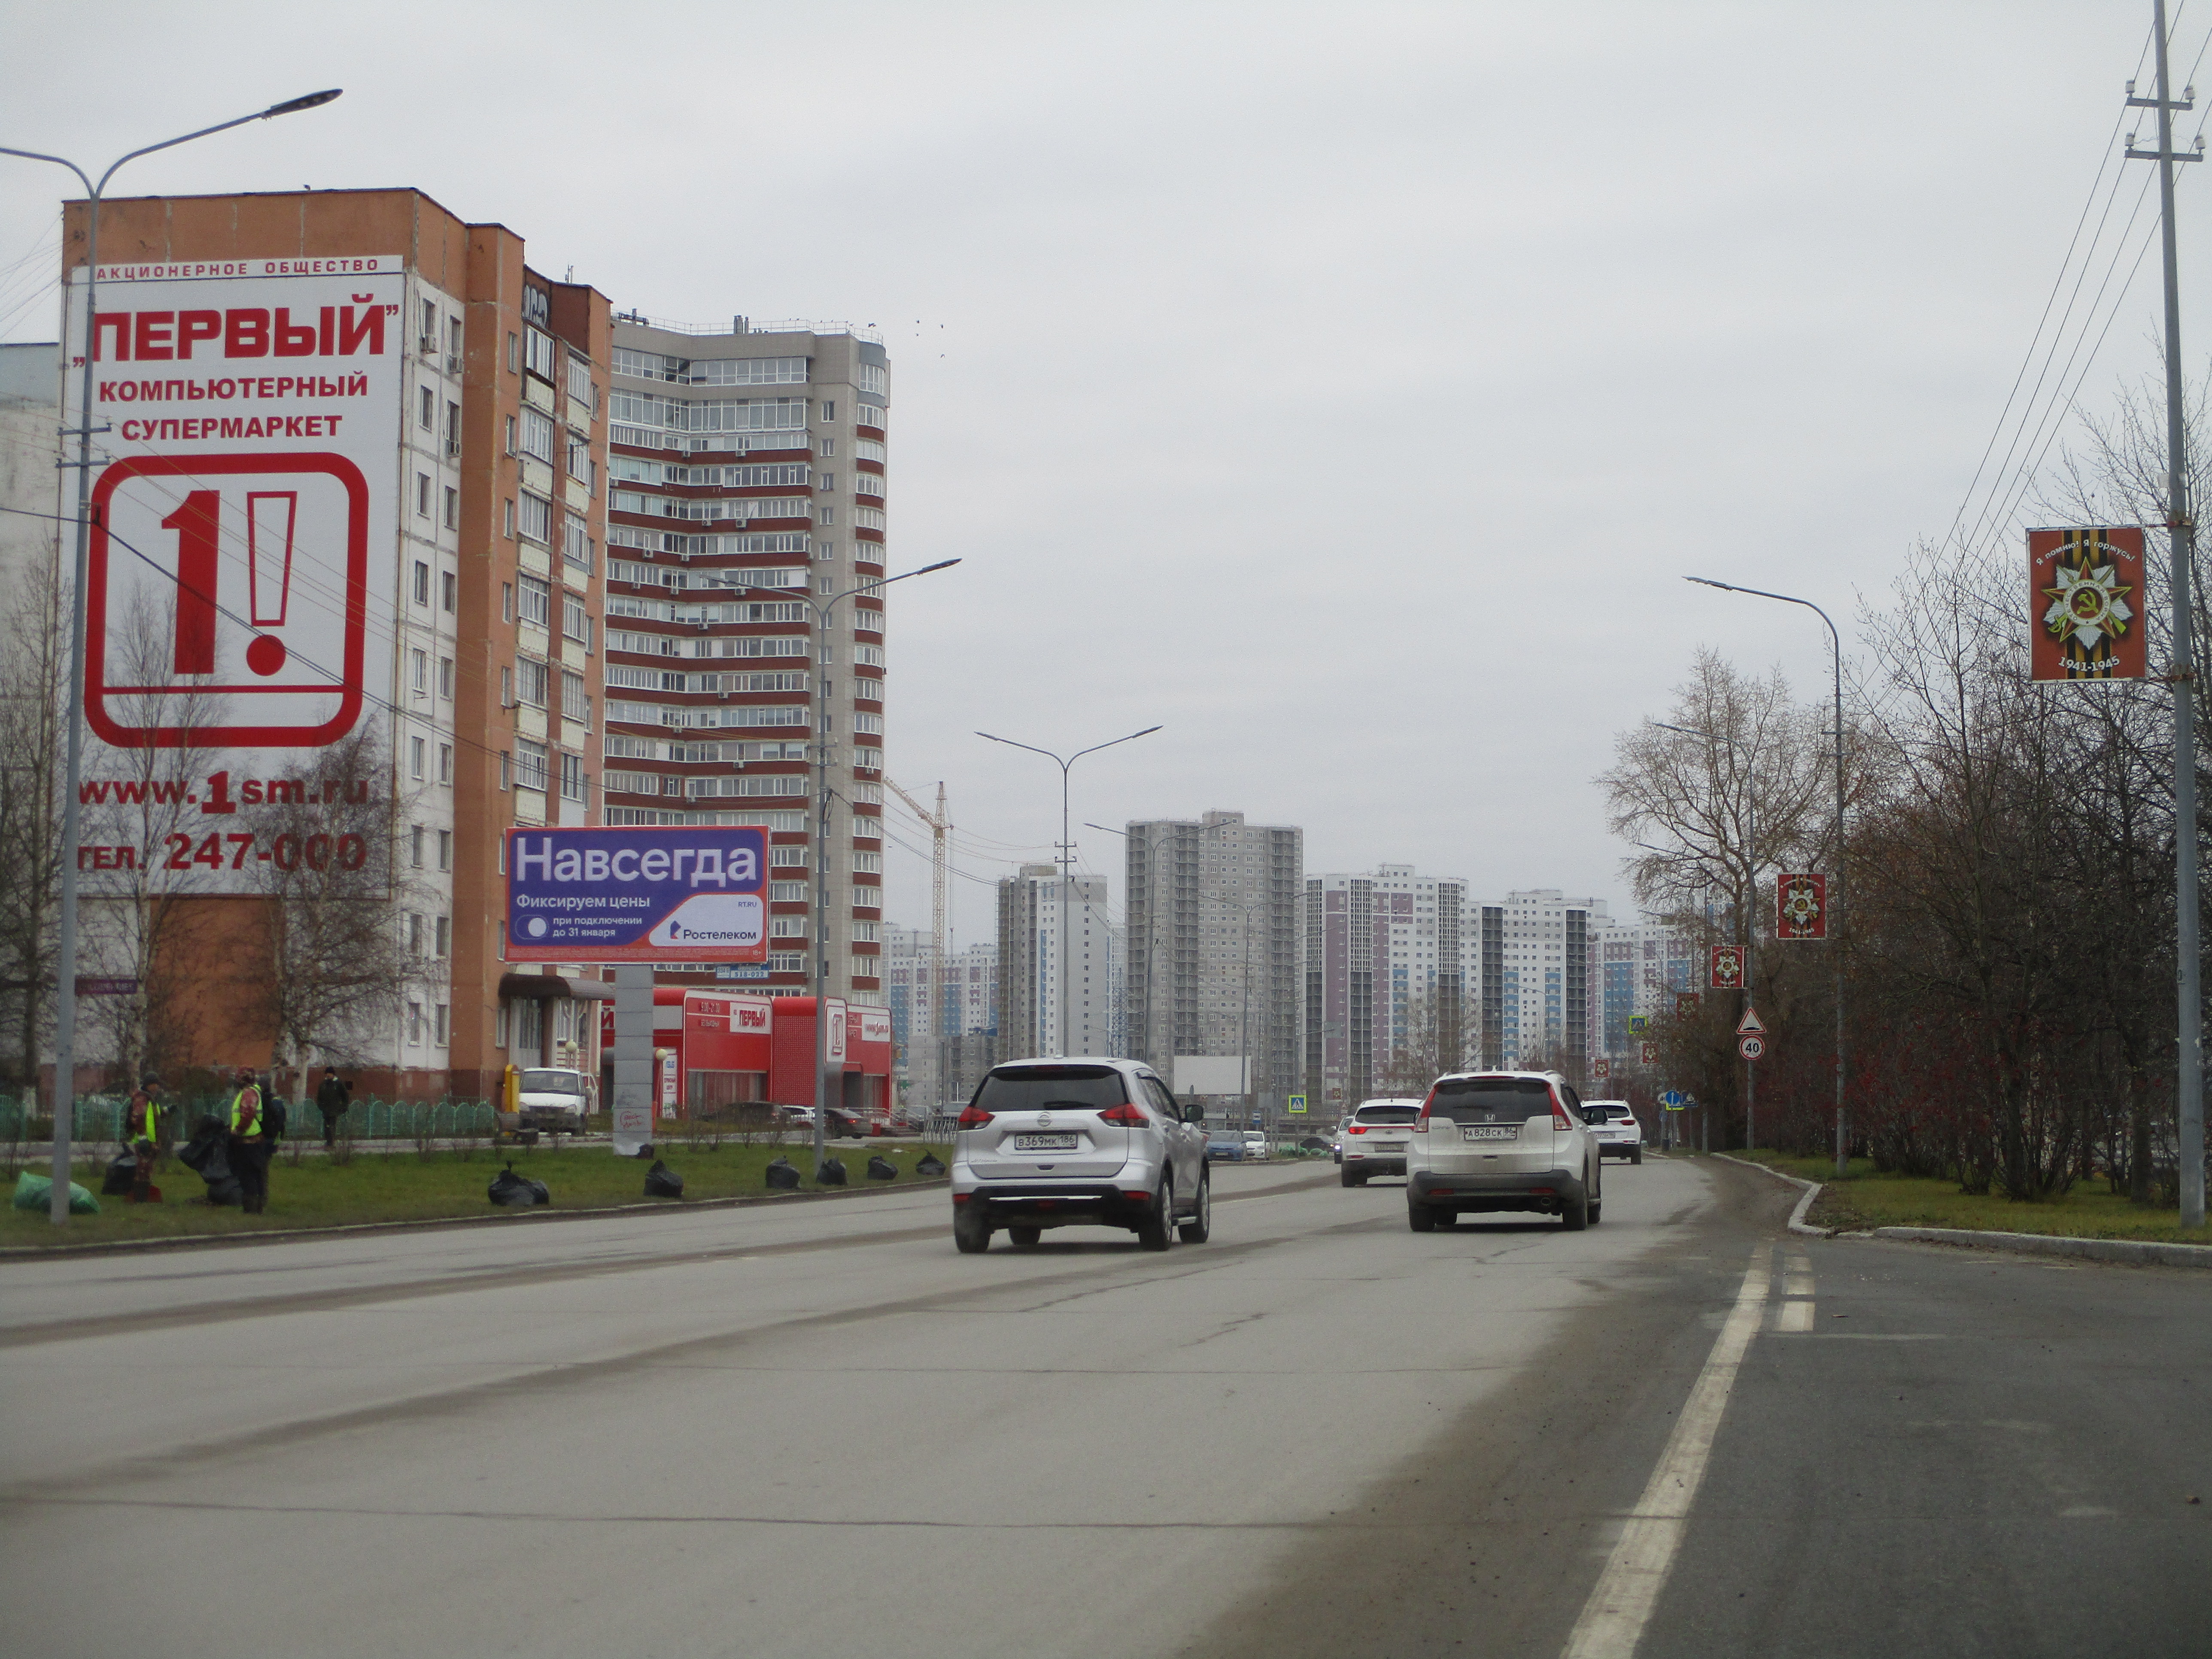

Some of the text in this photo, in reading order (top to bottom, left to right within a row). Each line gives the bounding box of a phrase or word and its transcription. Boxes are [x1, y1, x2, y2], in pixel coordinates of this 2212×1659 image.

[96, 259, 379, 280] АКЦИОНЕРНОЕ ОБЩЕСТВО
[100, 371, 368, 402] КОМПЬЮТЕРНЫЙ
[122, 416, 343, 441] СУПЕРМАРКЕТ
[2045, 541, 2079, 559] помню!
[2094, 541, 2136, 562] горжусь!
[2058, 655, 2120, 672] 1941-1945
[79, 770, 368, 814] www.1sm.ru
[163, 833, 368, 872] 247-000
[517, 837, 756, 887] Навсегда
[517, 894, 650, 911] Фиксируем цены
[553, 916, 642, 926] при подключении
[553, 928, 616, 937] до 31 января
[684, 929, 757, 939] Ростелеком
[1746, 1043, 1759, 1053] 40
